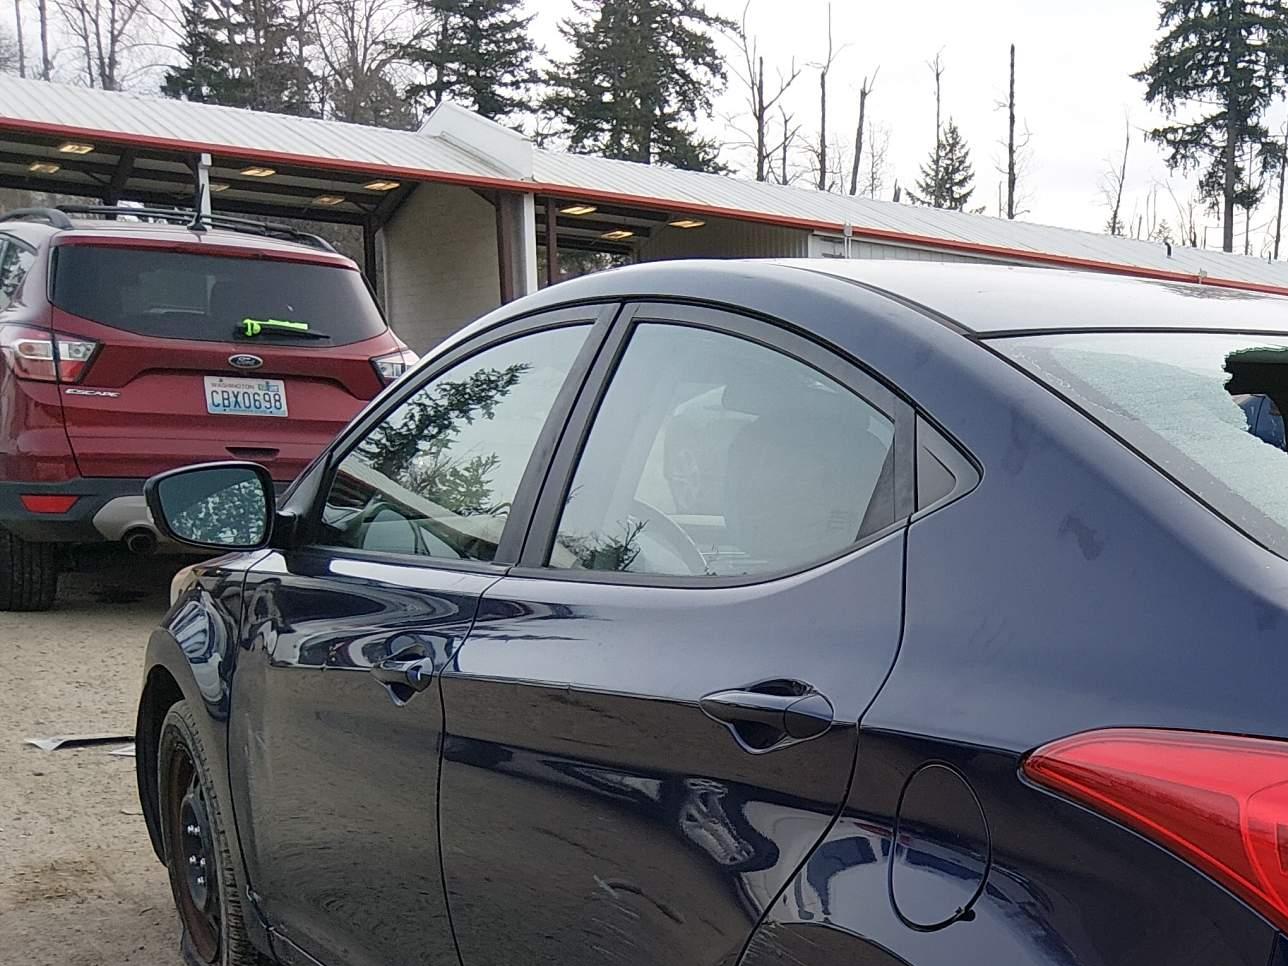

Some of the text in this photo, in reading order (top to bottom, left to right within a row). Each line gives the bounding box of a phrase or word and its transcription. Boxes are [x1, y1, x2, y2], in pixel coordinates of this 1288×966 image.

[210, 382, 255, 390] WASHINGTON
[64, 388, 121, 398] ESCAPE
[210, 389, 283, 410] CBX0698
